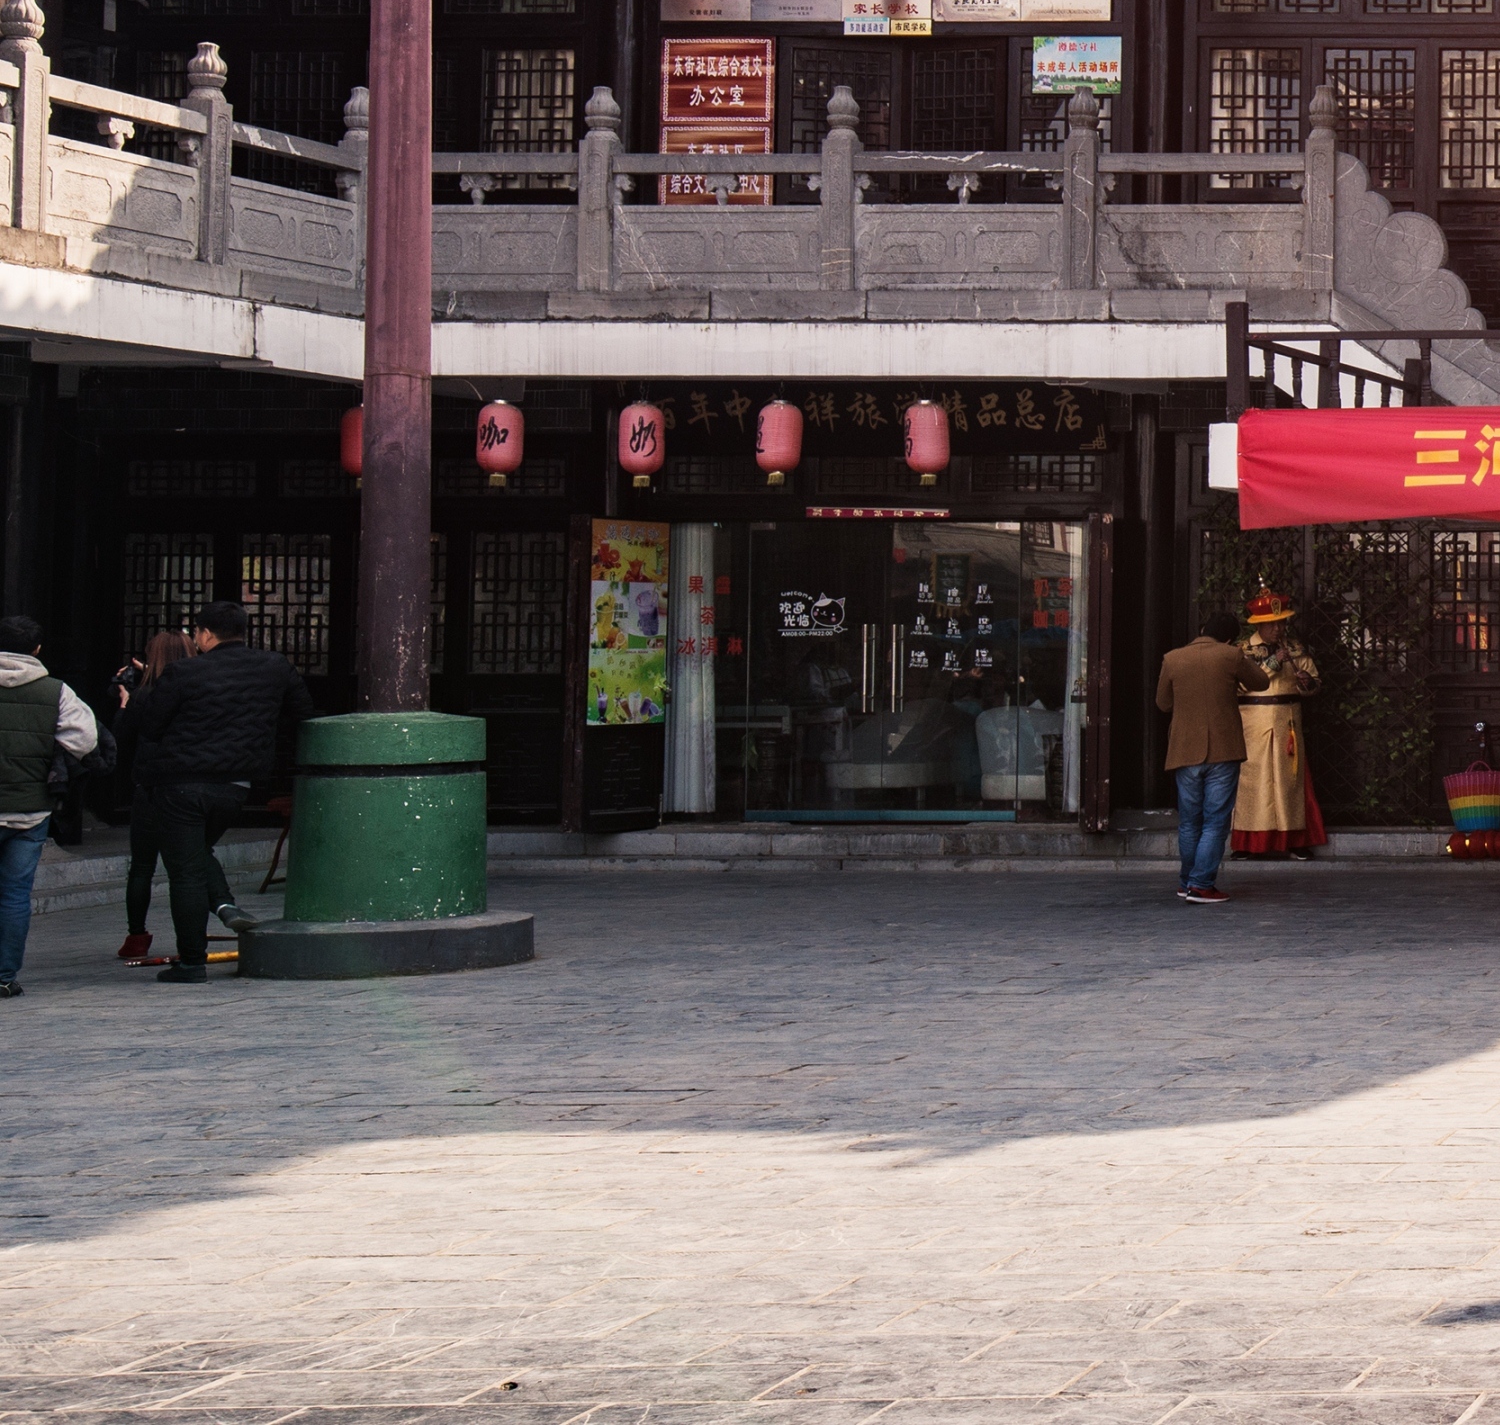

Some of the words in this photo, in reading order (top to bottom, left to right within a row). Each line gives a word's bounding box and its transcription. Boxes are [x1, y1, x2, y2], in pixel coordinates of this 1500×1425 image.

[853, 3, 919, 15] 家长学校
[849, 23, 885, 33] 多功能活动室
[895, 22, 927, 32] 市民学校
[673, 55, 762, 77] 东街社区综合减灾
[1037, 61, 1119, 73] 未成年人活动场所
[689, 85, 745, 107] 办公室
[670, 174, 760, 194] 综合文中心
[1033, 577, 1072, 597] 奶茶
[700, 605, 716, 625] 茶
[779, 601, 806, 614] 欢迎
[783, 614, 810, 627] 光临
[1033, 609, 1070, 628] 咖啡
[676, 636, 744, 656] 冰淇淋
